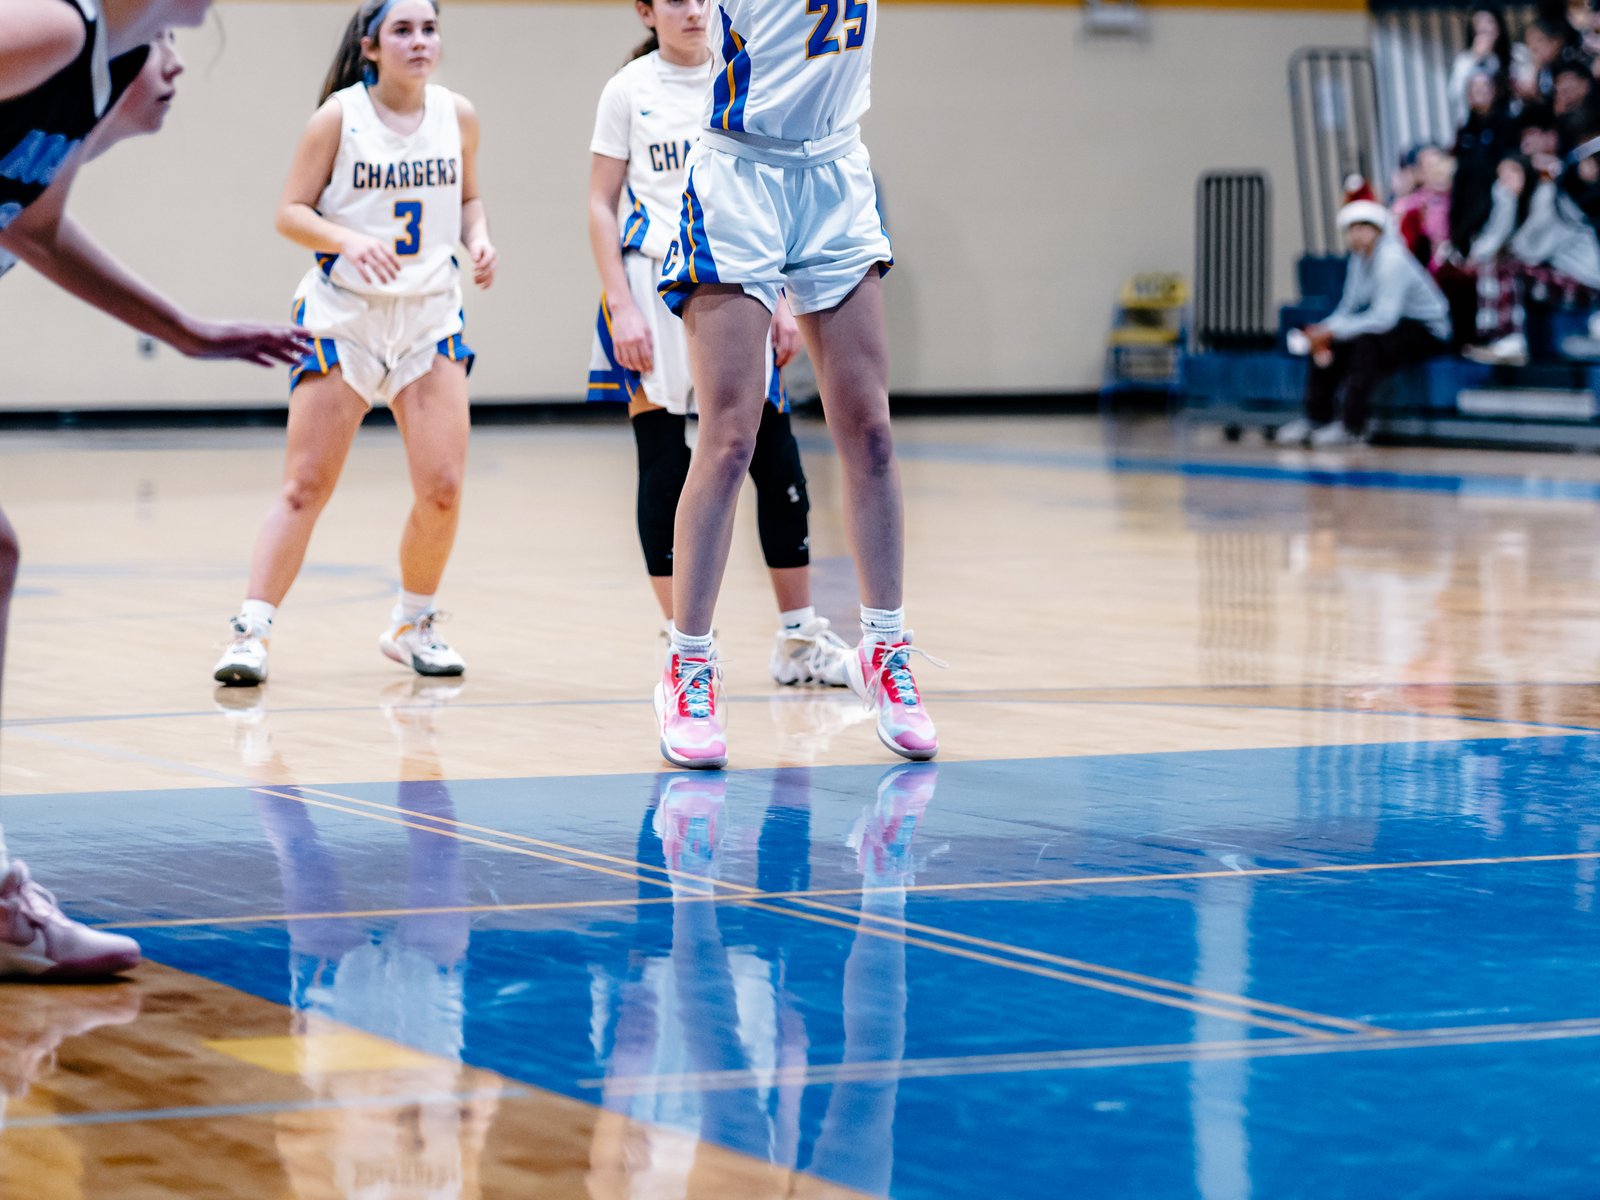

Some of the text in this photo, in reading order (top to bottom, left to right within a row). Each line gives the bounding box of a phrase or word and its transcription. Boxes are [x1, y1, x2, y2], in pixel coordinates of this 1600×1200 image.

[648, 137, 699, 172] CHA
[353, 158, 457, 189] CHARGERS
[393, 199, 423, 256] 3
